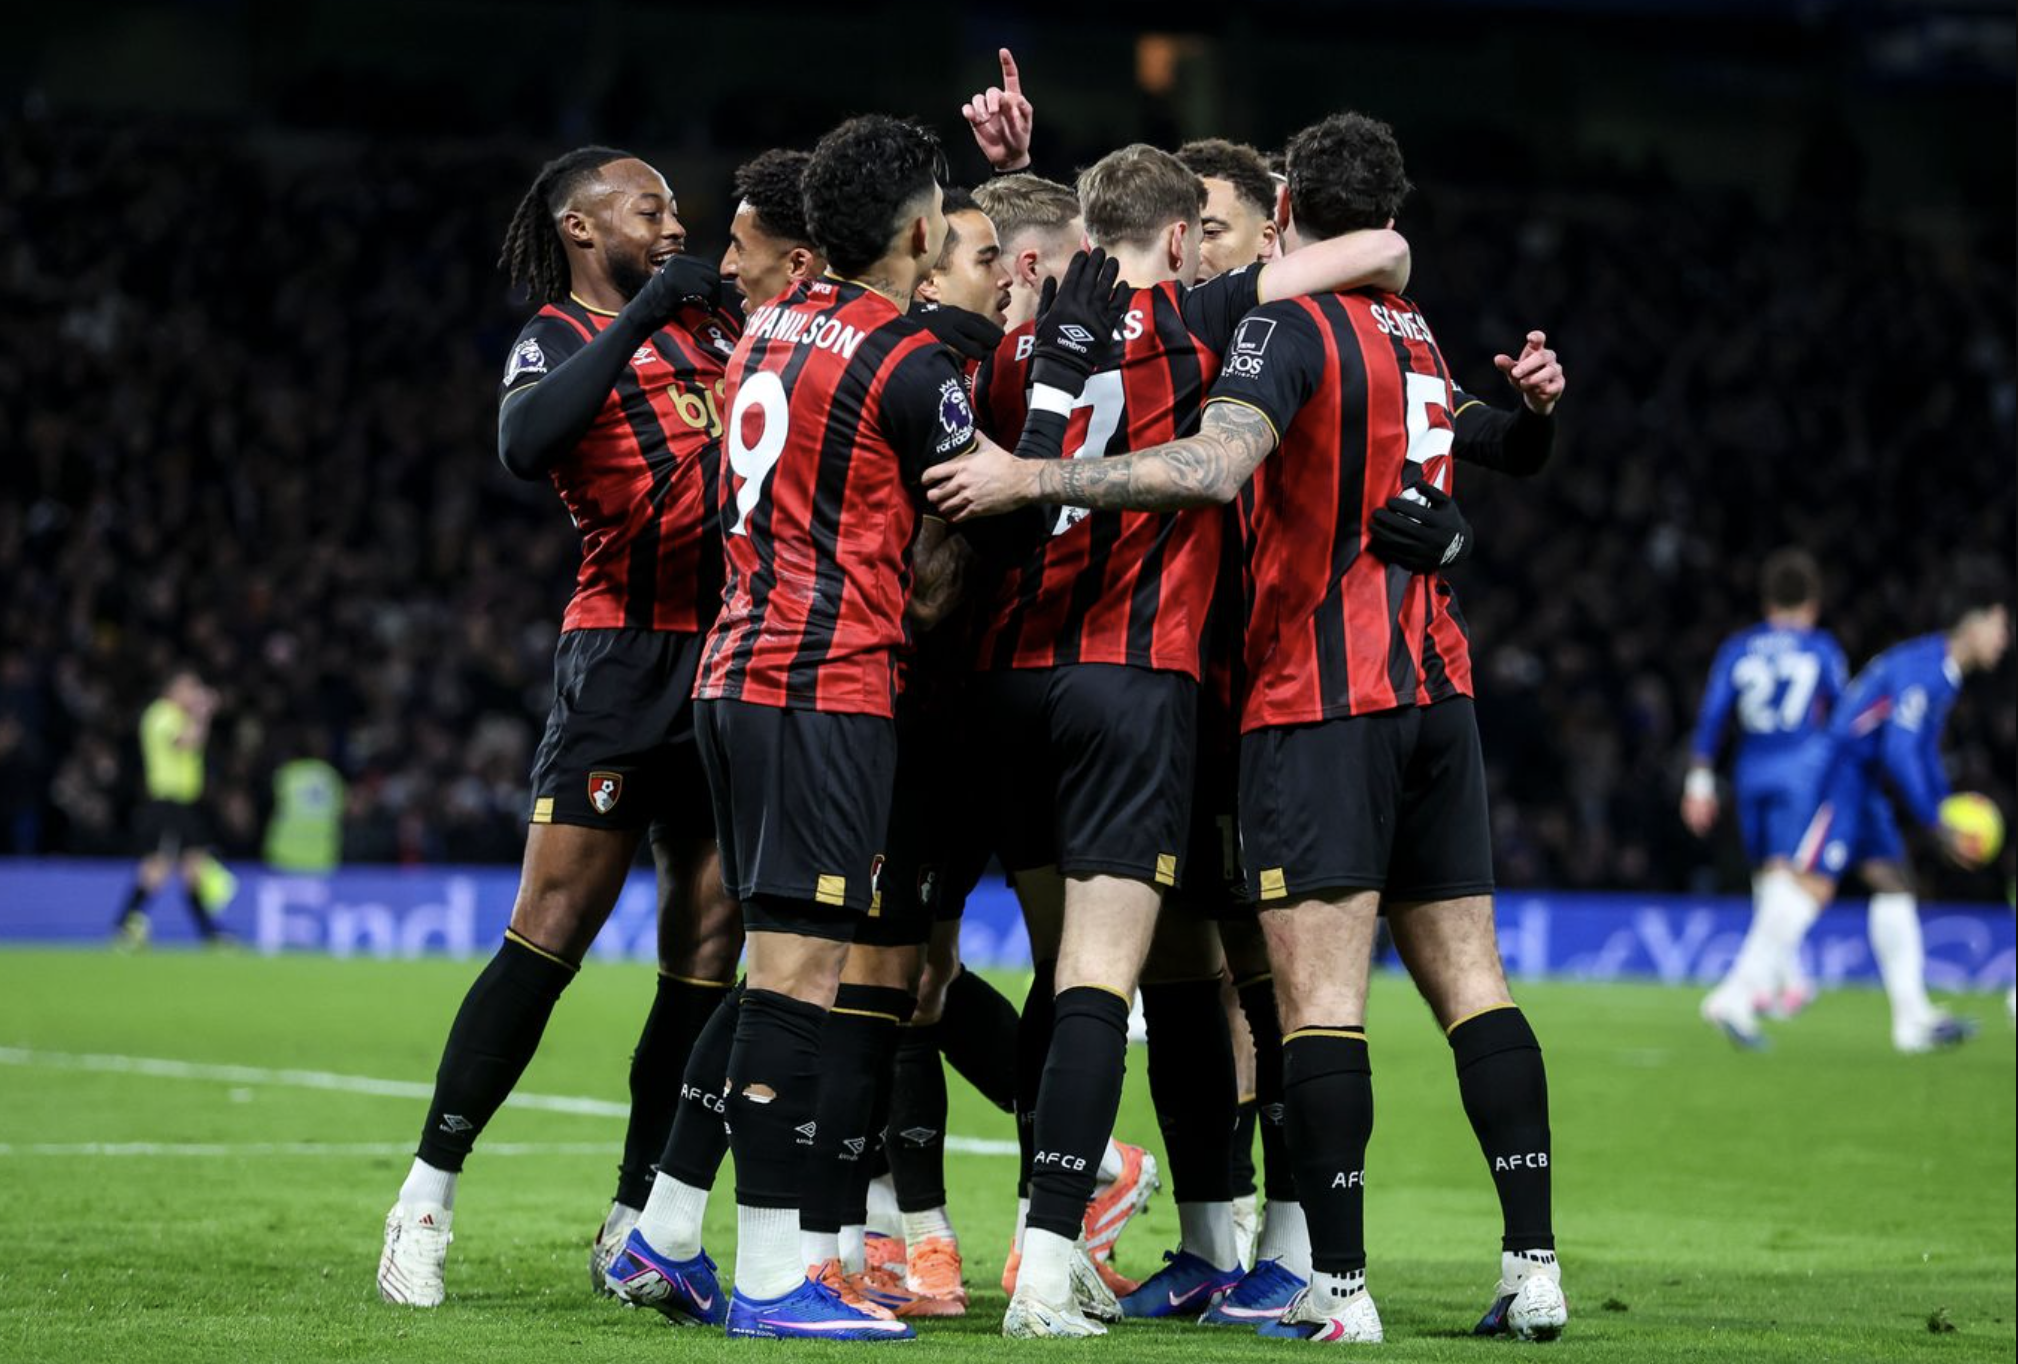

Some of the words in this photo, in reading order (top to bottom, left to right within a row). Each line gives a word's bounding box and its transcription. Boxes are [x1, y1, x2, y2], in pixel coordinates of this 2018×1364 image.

[1057, 337, 1087, 354] umbro
[728, 370, 789, 536] 9
[1051, 369, 1125, 536] 7
[1400, 372, 1455, 506] 5
[1732, 651, 1820, 734] 27
[257, 872, 475, 960] End
[681, 1083, 726, 1113] AFCB
[1034, 1151, 1086, 1171] AFCB
[1495, 1152, 1549, 1172] AFCB
